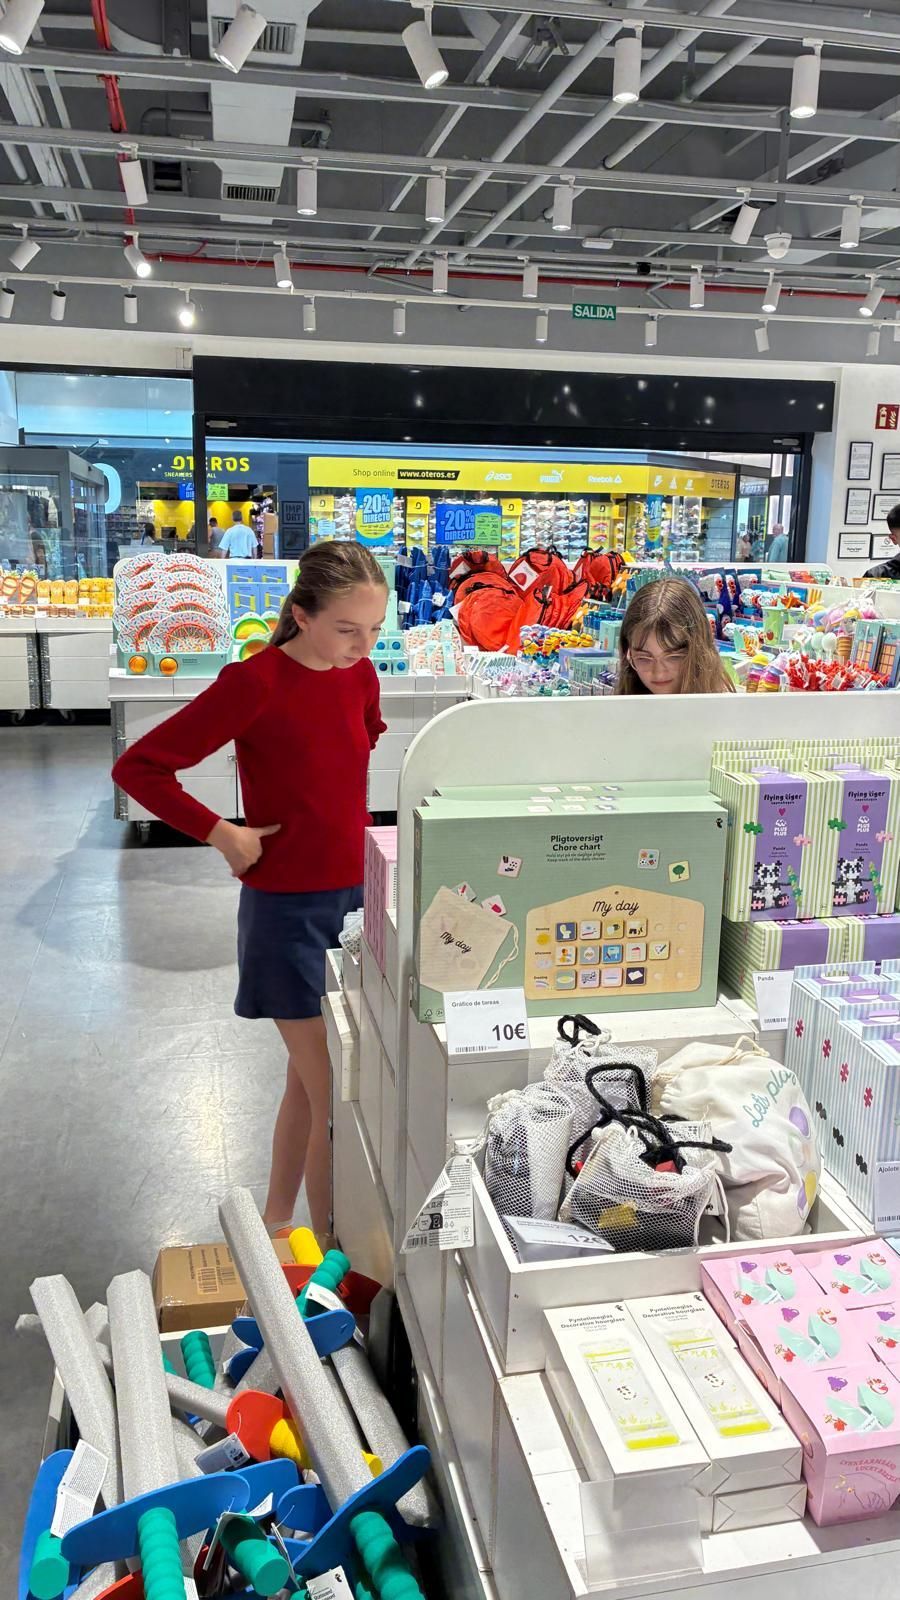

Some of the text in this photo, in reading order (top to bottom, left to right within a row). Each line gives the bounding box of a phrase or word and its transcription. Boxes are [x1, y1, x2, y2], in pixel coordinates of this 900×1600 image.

[574, 305, 615, 319] SALIDA
[171, 455, 250, 472] OTROS
[353, 469, 456, 479] Shop online www.oteros.es
[764, 793, 803, 802] flying tiger
[869, 790, 886, 798] tiger
[550, 834, 604, 845] Pligtoversigt
[579, 843, 601, 851] chart
[592, 900, 640, 917] My day
[440, 931, 472, 954] My day
[491, 1023, 527, 1041] 10€
[878, 1166, 899, 1174] Ajolote
[642, 1311, 675, 1319] Decorative
[560, 1321, 595, 1329] Decorative
